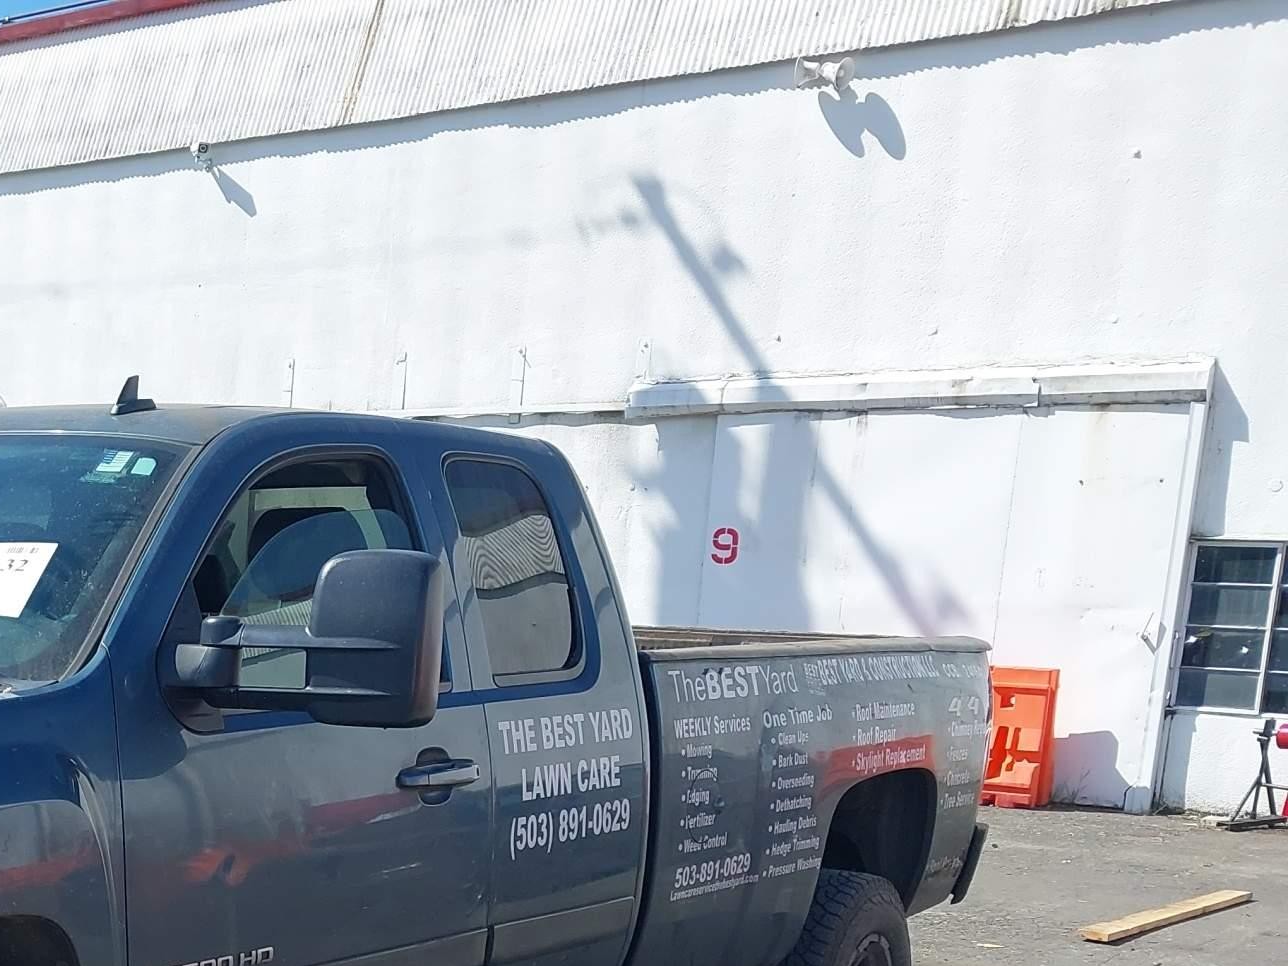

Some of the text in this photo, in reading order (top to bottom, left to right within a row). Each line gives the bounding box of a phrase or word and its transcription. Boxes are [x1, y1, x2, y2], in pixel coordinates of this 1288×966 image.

[711, 527, 739, 565] 9
[816, 659, 842, 686] BEST
[839, 657, 865, 684] YARD
[763, 704, 833, 729] One Time Job
[856, 702, 872, 721] Roof
[498, 708, 633, 754] THE BEST YARD
[674, 714, 751, 739] WEEKLY Services
[857, 725, 896, 747] Roof Repair
[686, 743, 713, 758] Mowing
[778, 752, 809, 768] Bark Dust
[521, 755, 621, 801] LAWN CARE
[777, 774, 814, 790] Overseeding
[510, 798, 631, 861] (503) 891-0629
[703, 832, 728, 849] Control
[674, 853, 751, 888] 503-891-0629
[768, 861, 796, 878] Pressure
